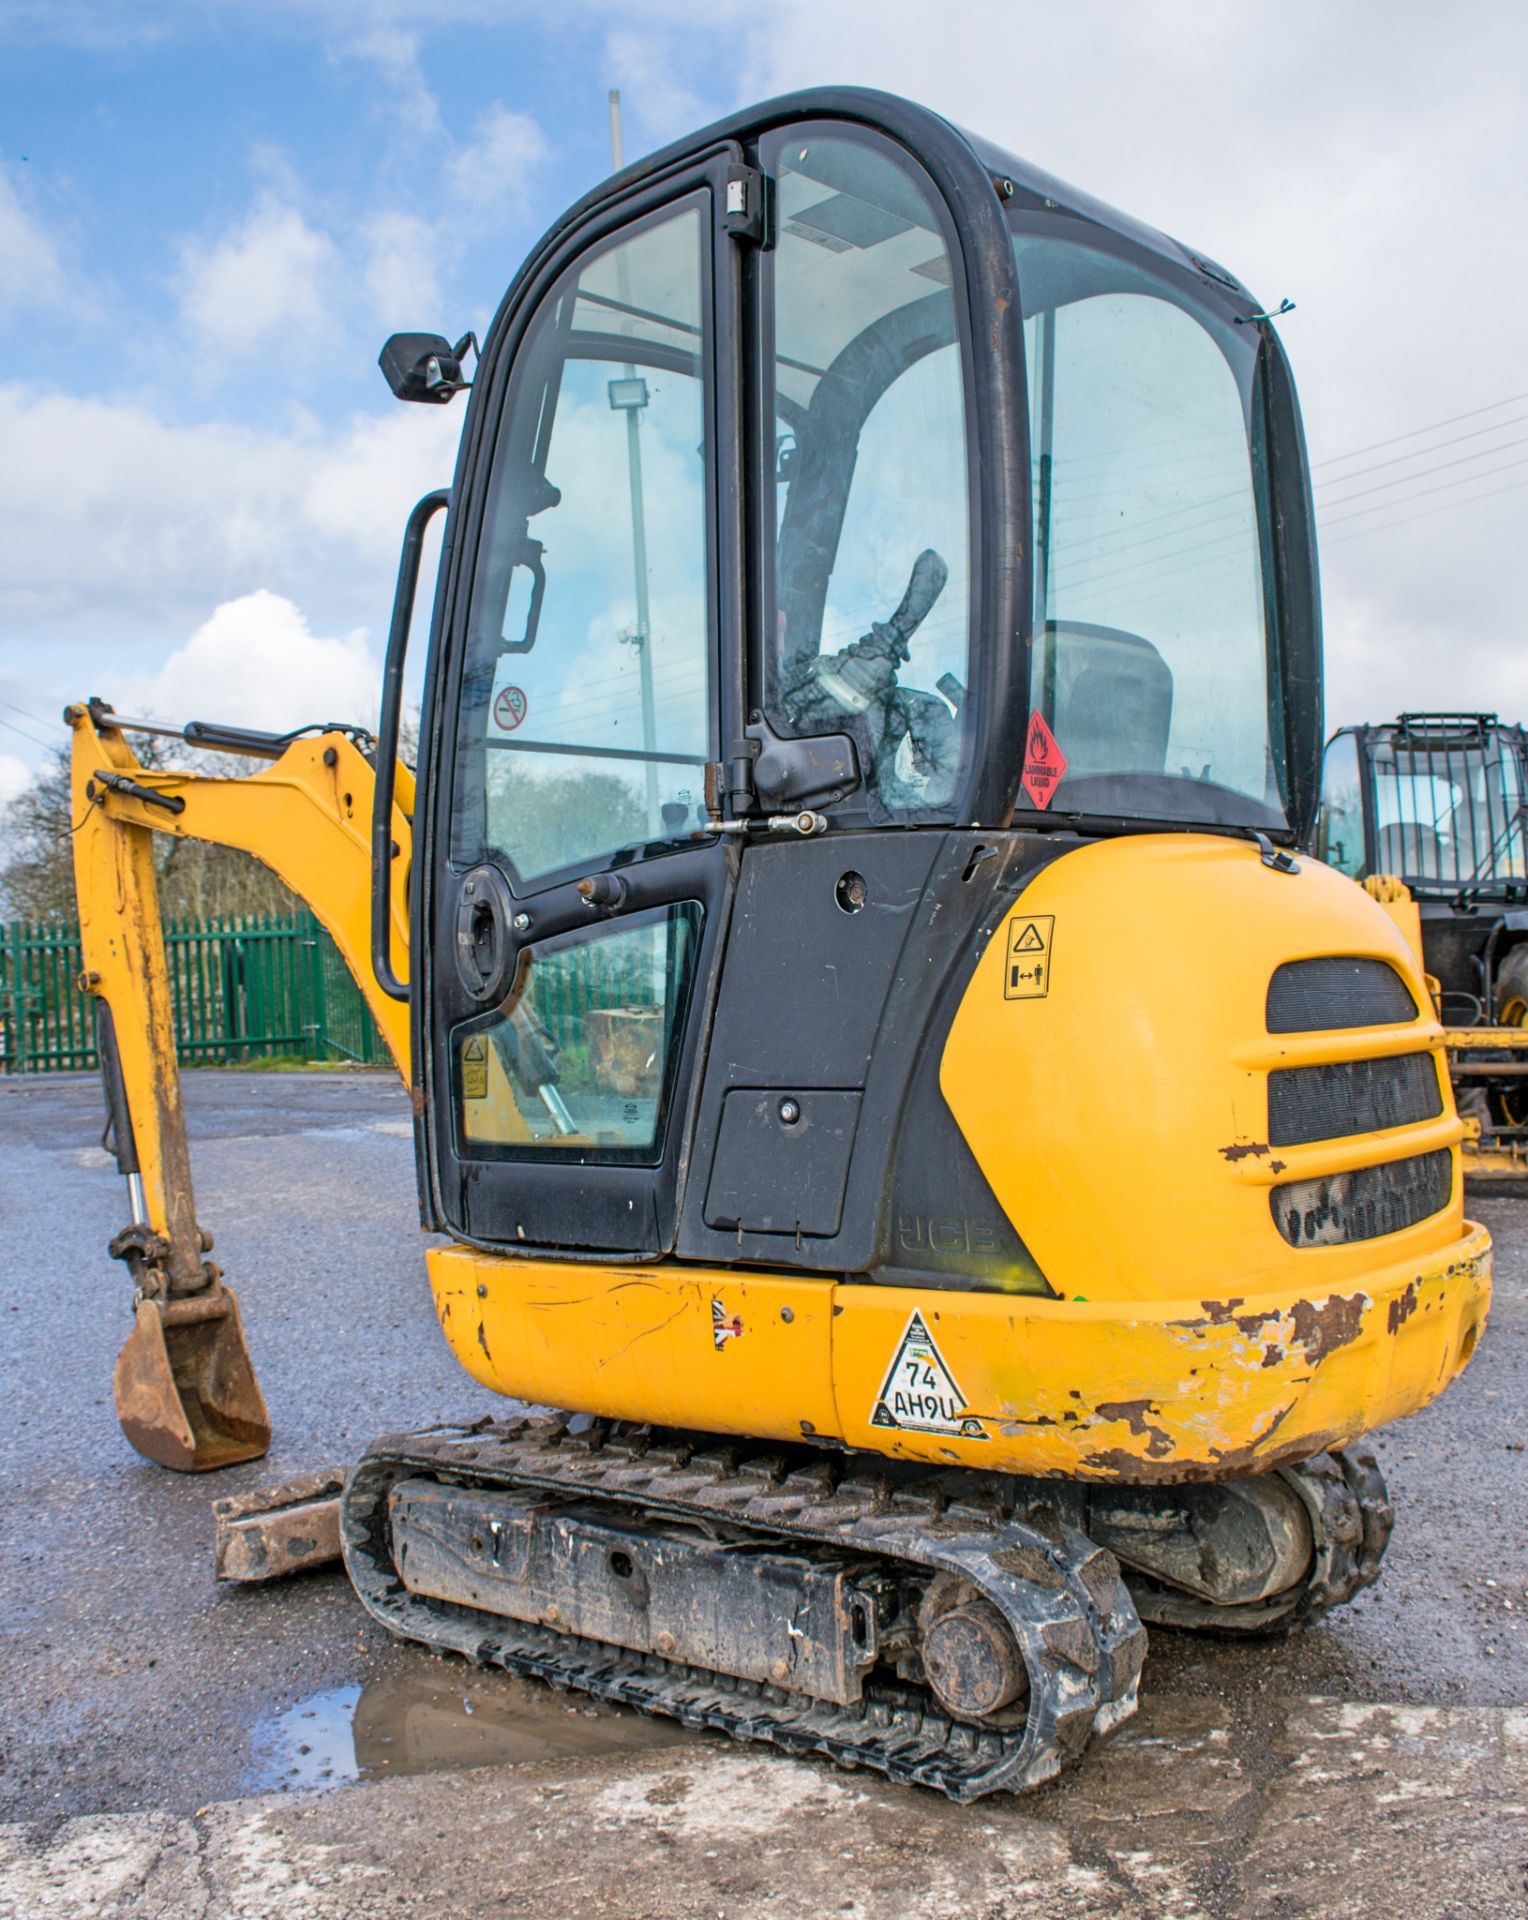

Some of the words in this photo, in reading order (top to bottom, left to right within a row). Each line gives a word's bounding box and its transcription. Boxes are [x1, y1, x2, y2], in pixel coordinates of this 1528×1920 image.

[1031, 775, 1050, 788] LIQUID
[897, 1215, 1001, 1254] JCB
[905, 1361, 937, 1390] 74
[894, 1391, 956, 1422] AH9U
